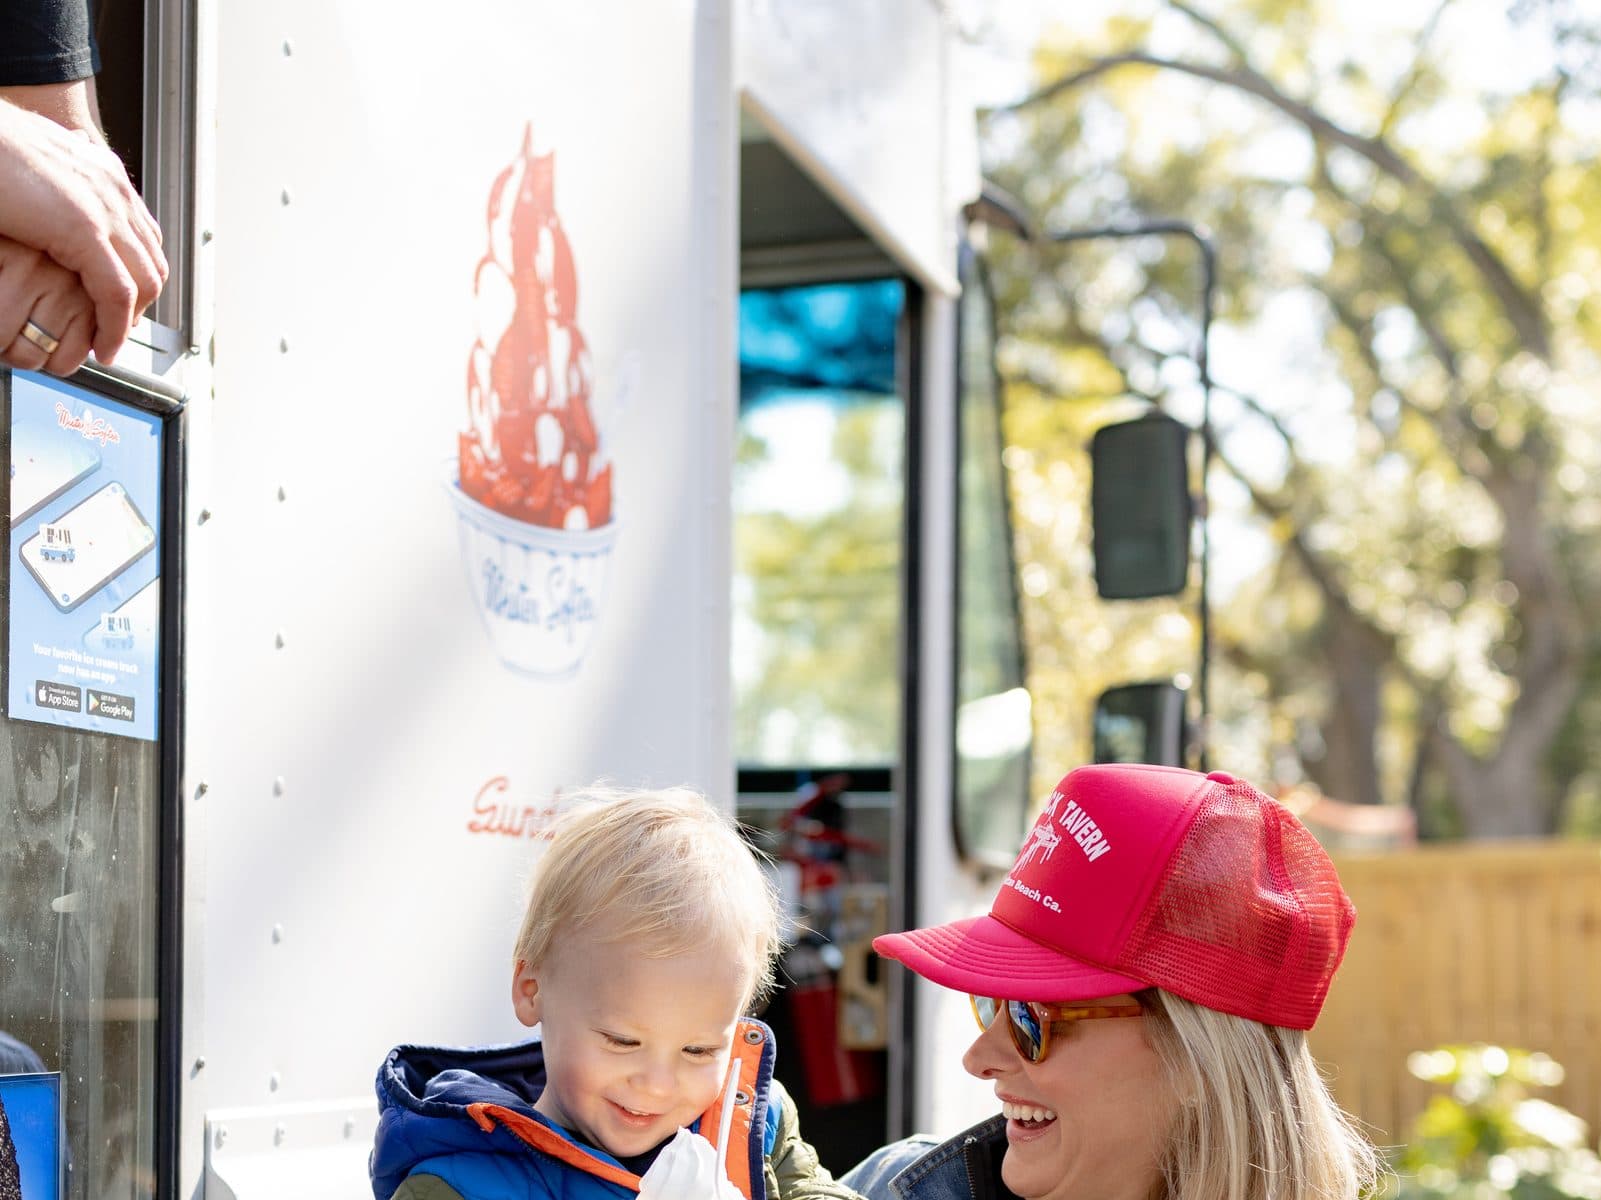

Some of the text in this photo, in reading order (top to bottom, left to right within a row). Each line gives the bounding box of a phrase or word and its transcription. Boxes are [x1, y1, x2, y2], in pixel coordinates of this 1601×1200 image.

[48, 694, 79, 708] App Store
[100, 703, 133, 720] Google Play
[1059, 799, 1112, 862] TAVERN
[1014, 879, 1042, 903] Beach
[1042, 896, 1062, 914] Ca.
